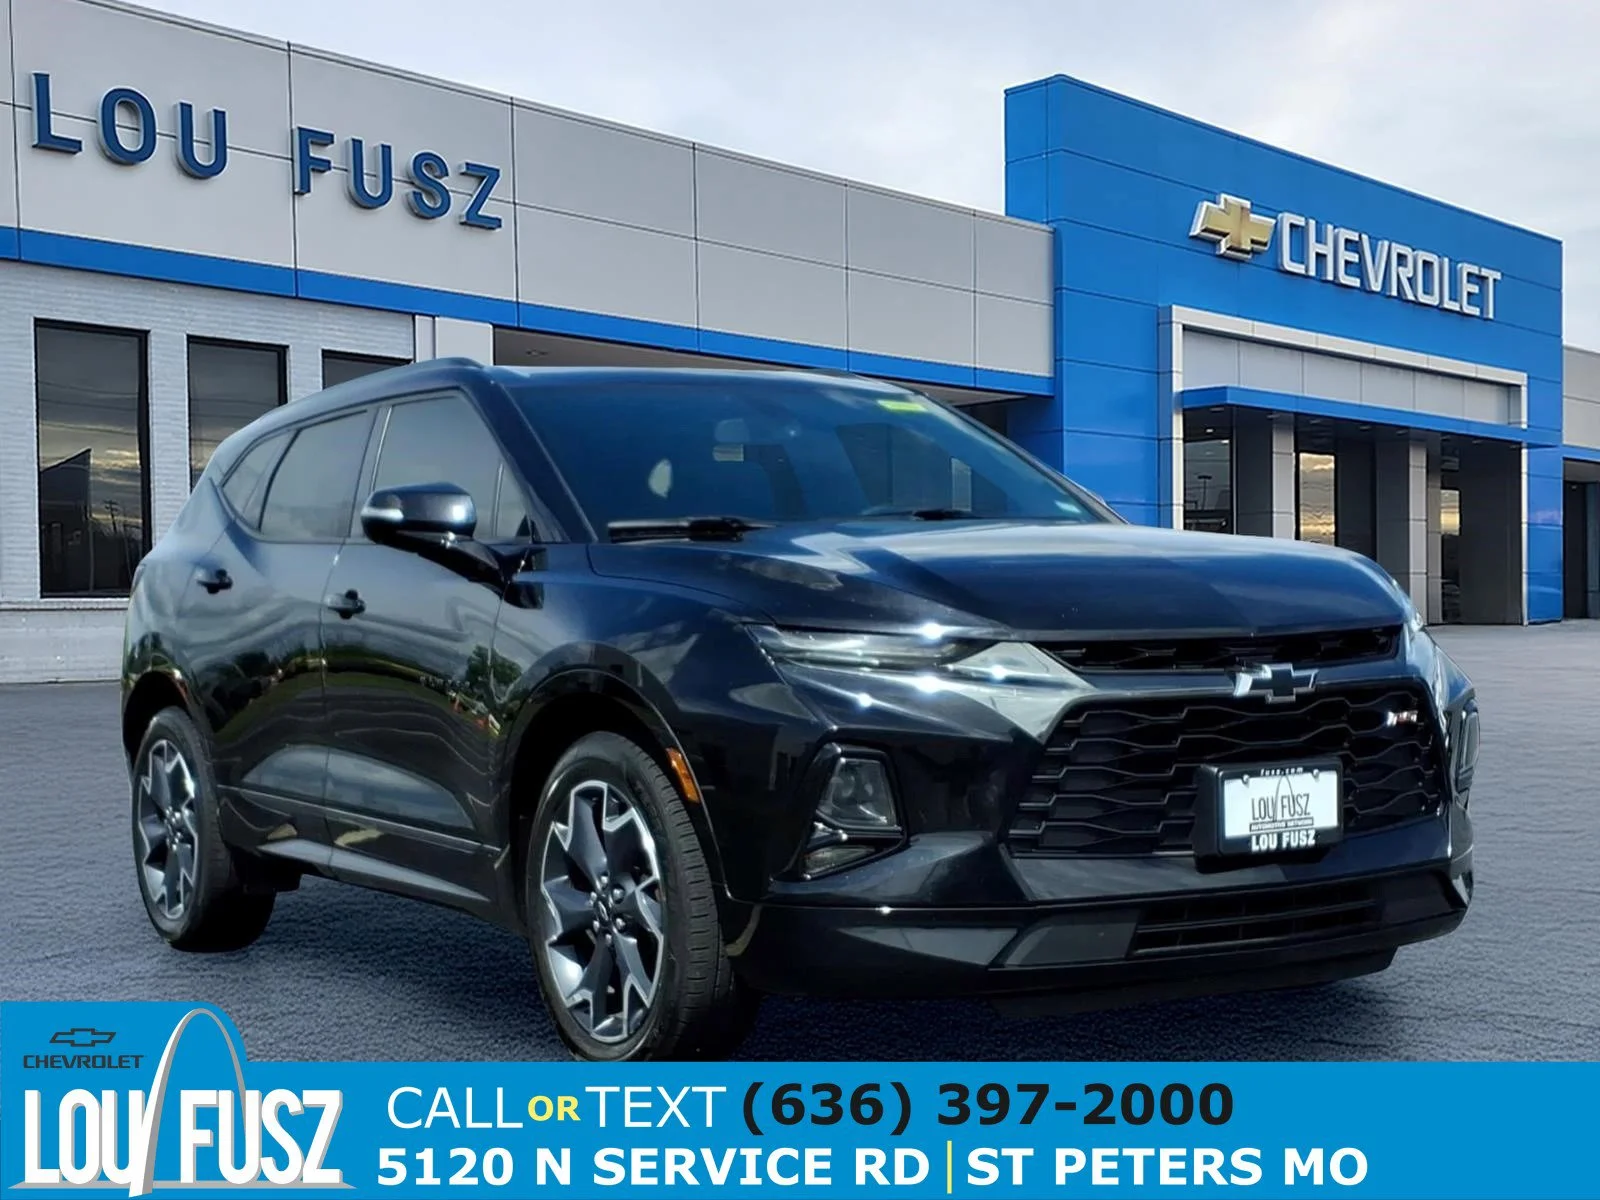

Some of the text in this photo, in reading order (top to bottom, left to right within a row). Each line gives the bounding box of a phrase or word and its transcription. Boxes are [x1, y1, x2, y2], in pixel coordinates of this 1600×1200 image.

[31, 72, 503, 231] LOU FUSZ
[1277, 211, 1502, 320] CHEVROLET
[1251, 792, 1311, 822] LOU FUSZ
[1251, 829, 1316, 852] LOU FUSZ
